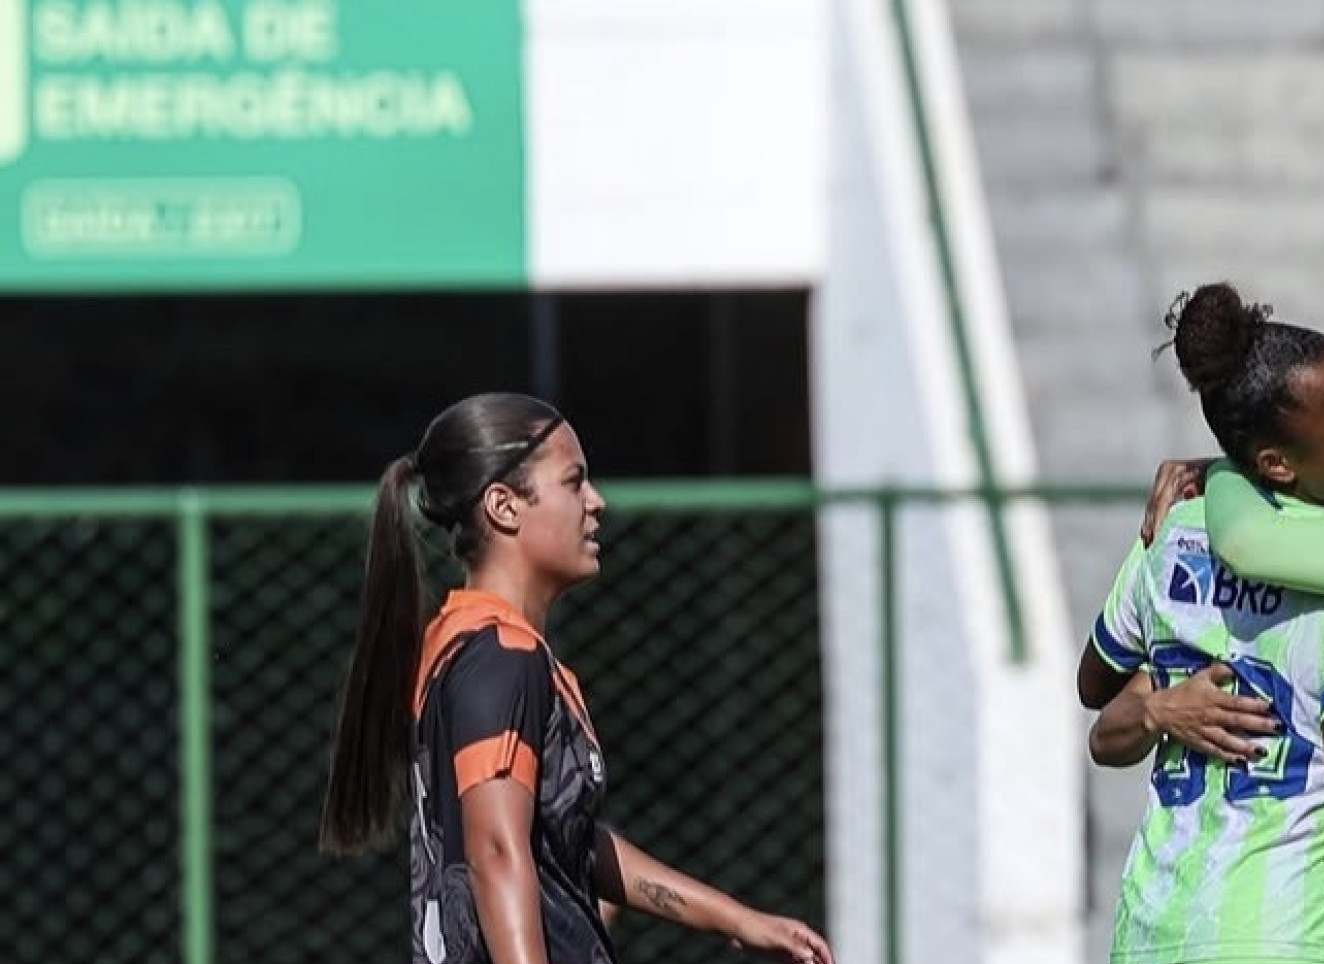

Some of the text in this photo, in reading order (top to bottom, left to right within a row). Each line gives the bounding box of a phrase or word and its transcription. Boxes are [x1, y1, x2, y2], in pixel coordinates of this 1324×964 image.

[243, 0, 338, 62] DE
[36, 69, 471, 138] EMERGÊNCIA
[1213, 565, 1285, 614] BRB
